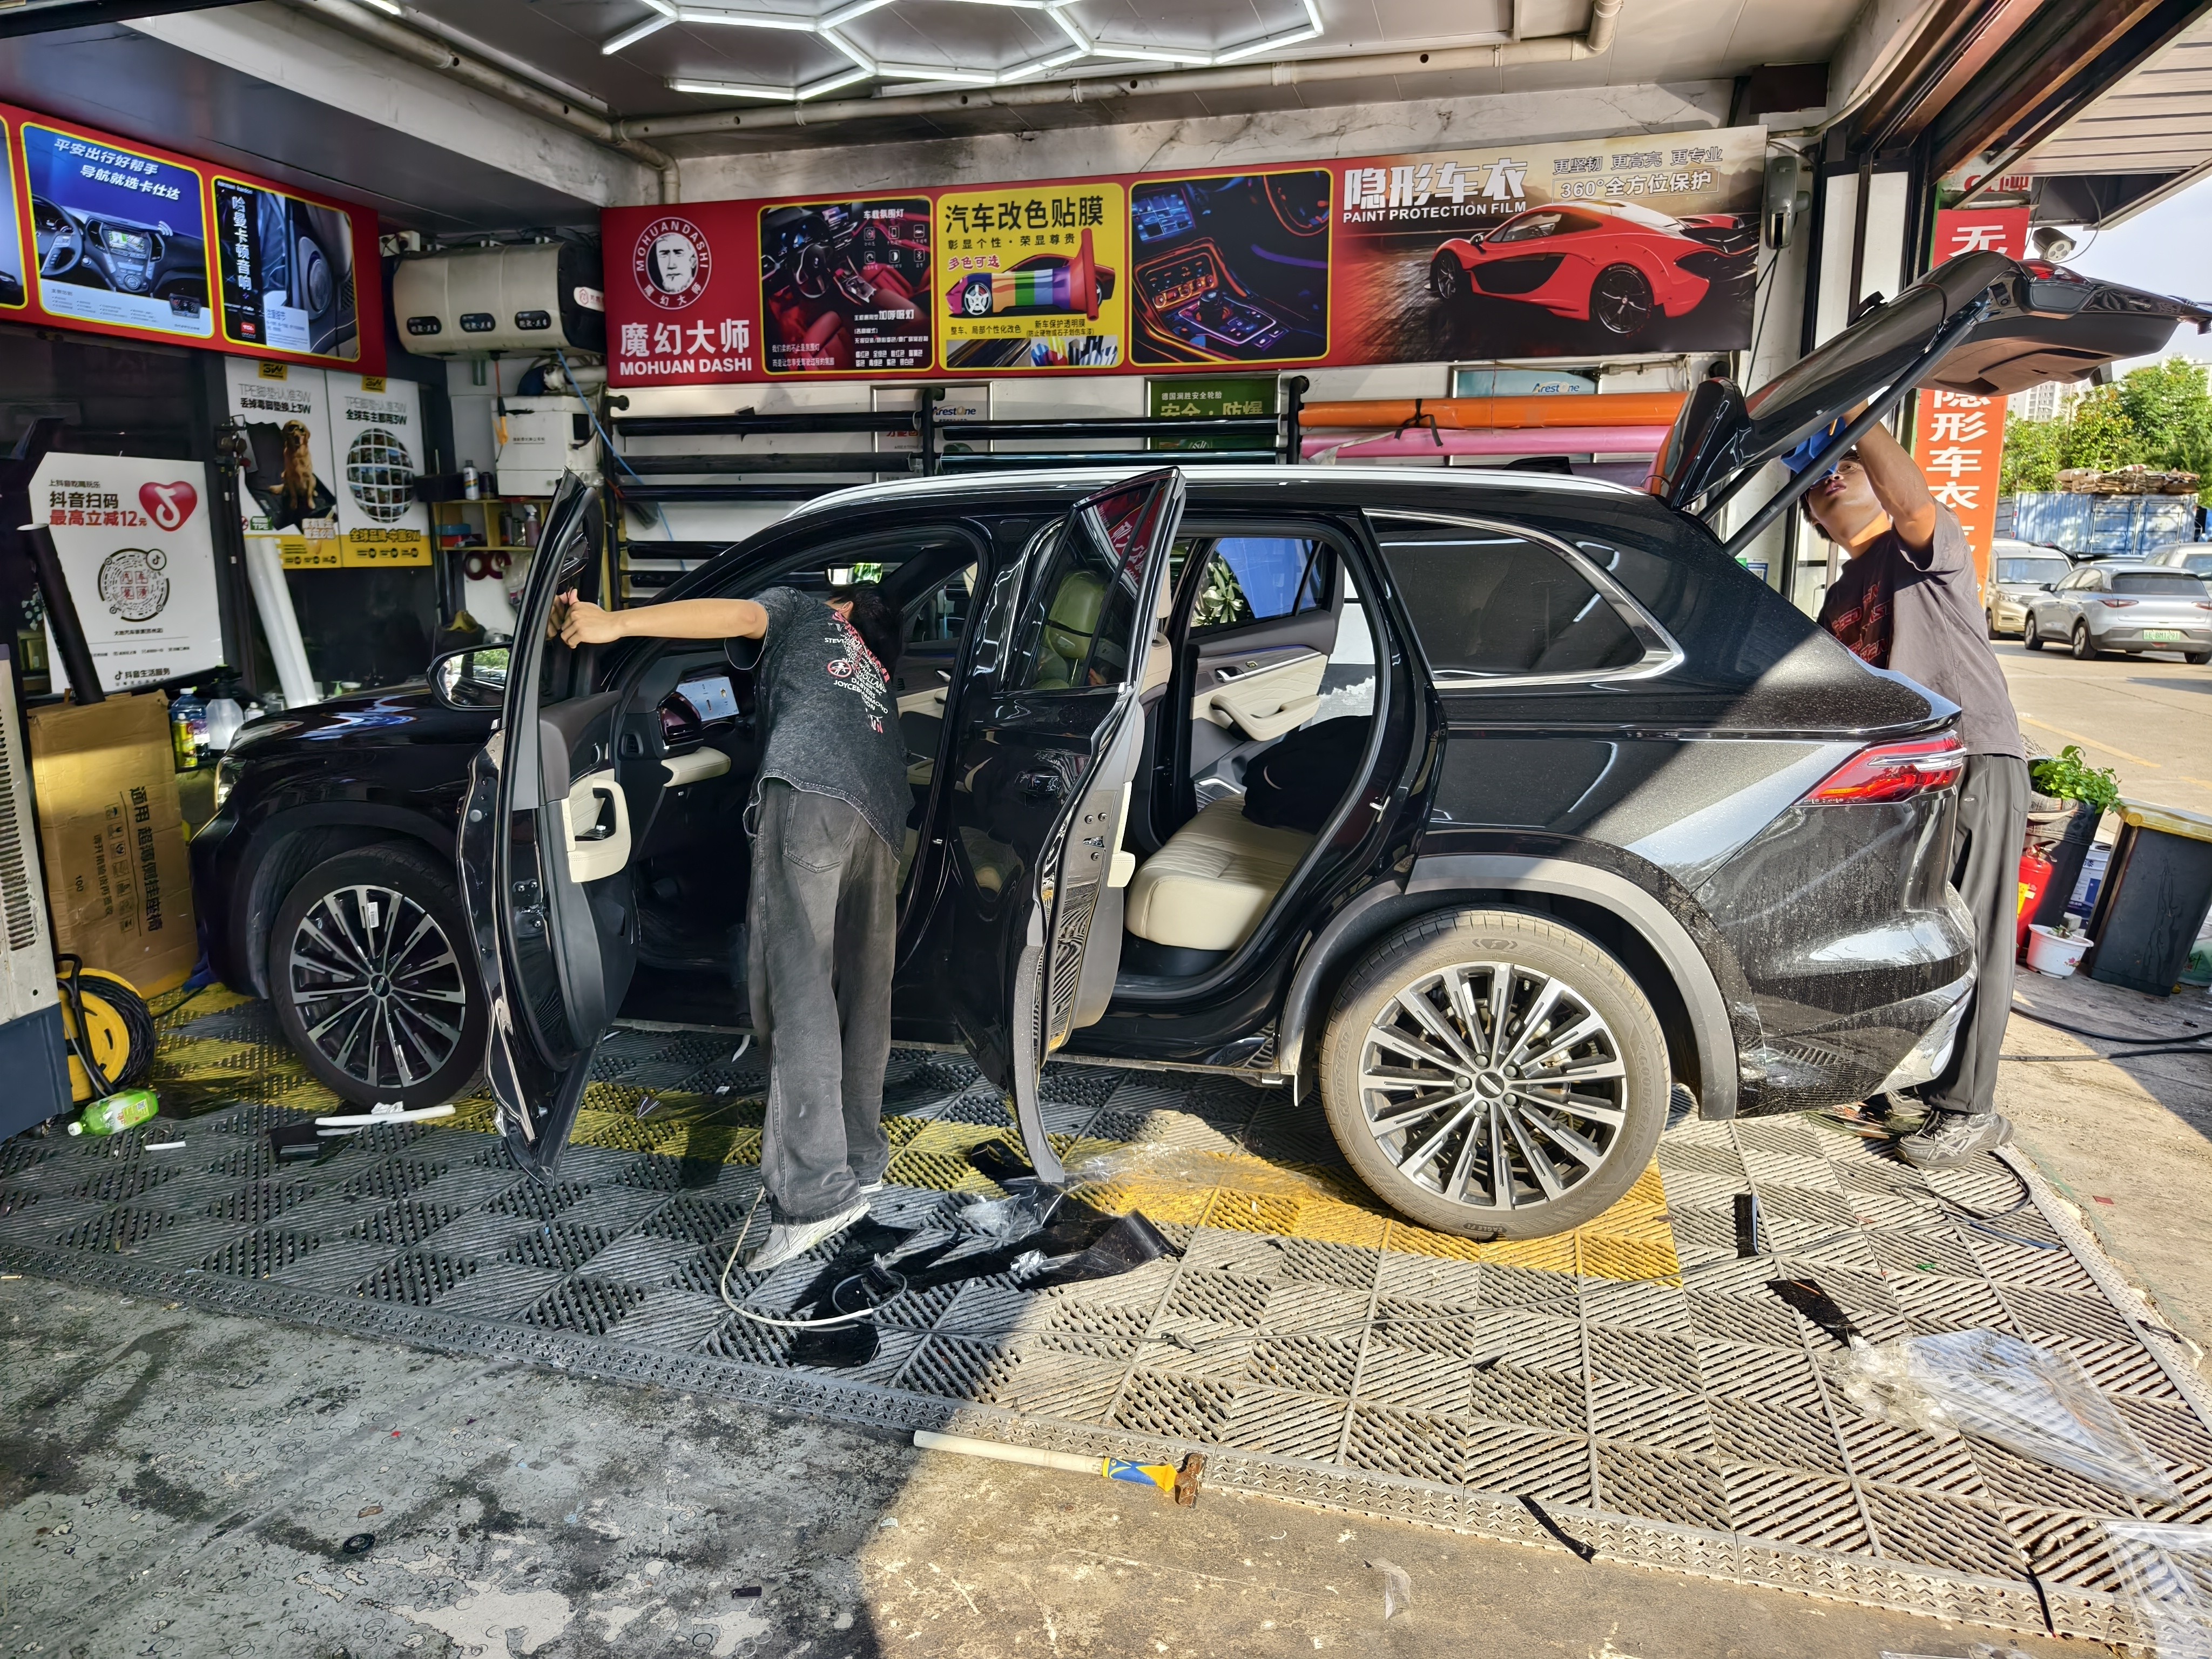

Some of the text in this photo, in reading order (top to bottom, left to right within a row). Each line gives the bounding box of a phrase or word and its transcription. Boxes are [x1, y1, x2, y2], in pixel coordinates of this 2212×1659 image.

[55, 138, 159, 175] 平安出行好帮手
[1553, 146, 1723, 175] 更坚韧 更高亮 更专业
[80, 164, 181, 200] 导航就选卡仕达
[1344, 158, 1527, 211] 隐形车衣
[1560, 171, 1711, 198] 360°全方位保护
[946, 195, 1103, 233] 汽车改色贴膜
[1343, 201, 1526, 223] PAINT PROTECTION FILM
[232, 195, 252, 291] 哈曼卡顿音响
[947, 254, 1001, 271] 多色可选
[643, 284, 702, 306] 魔幻大师
[620, 319, 750, 357] 魔幻大师
[950, 325, 1021, 335] 整车、局部个性化改色
[1035, 319, 1085, 328] 新车保护透明膜
[621, 358, 752, 375] MOHUAN DASHI
[50, 491, 119, 509] 抖音扫码
[50, 509, 147, 527] 最高立减12元
[130, 786, 150, 824] 通用
[1334, 1031, 1351, 1119] GOODYEAR
[1632, 1056, 1653, 1145] GOODYEAR
